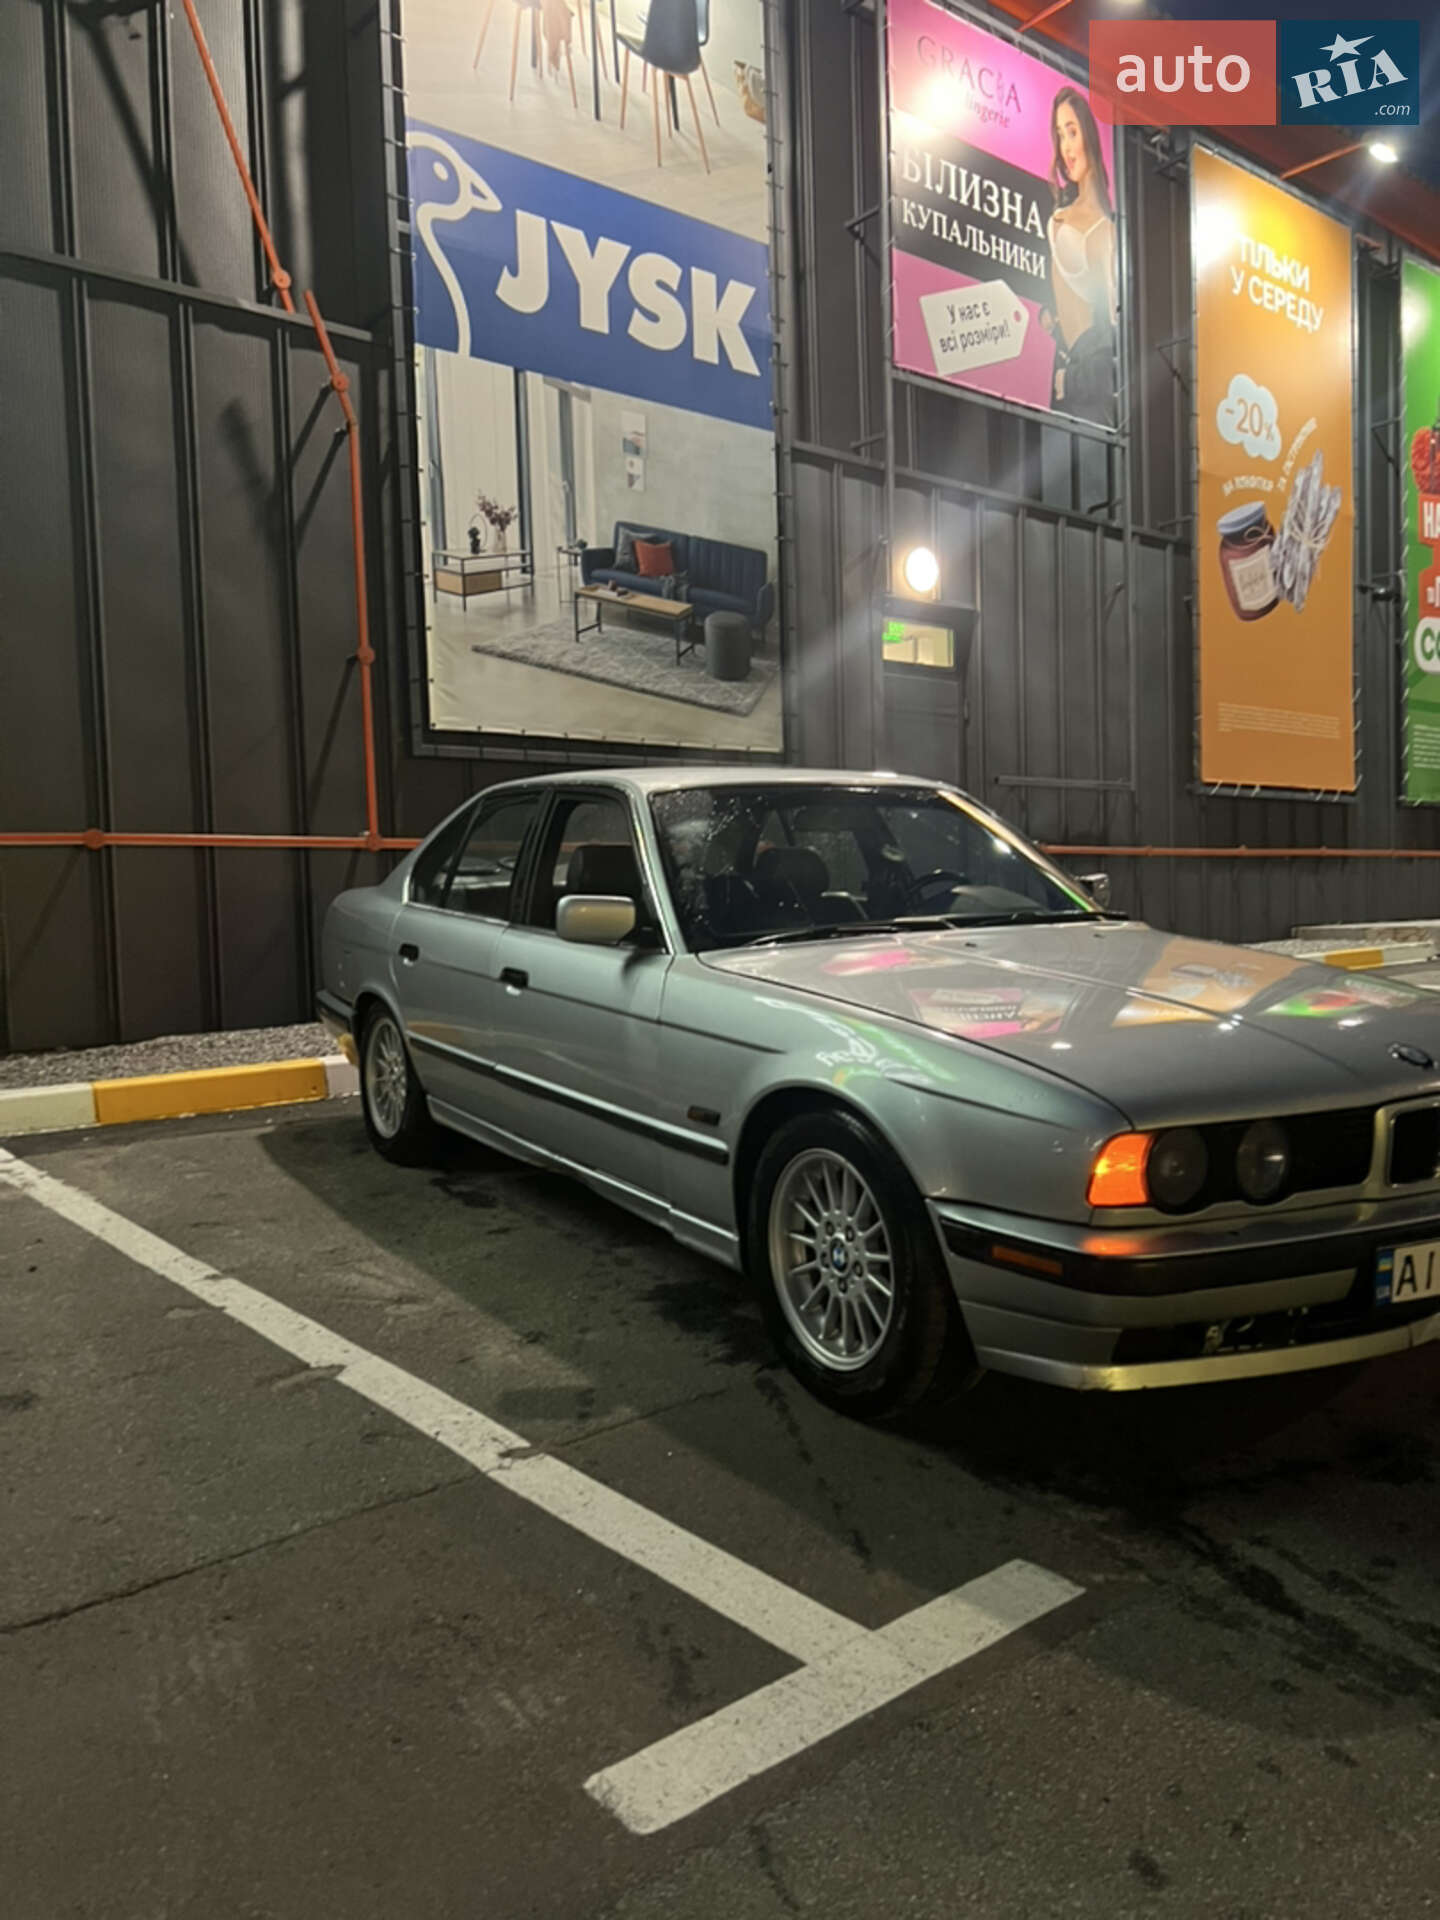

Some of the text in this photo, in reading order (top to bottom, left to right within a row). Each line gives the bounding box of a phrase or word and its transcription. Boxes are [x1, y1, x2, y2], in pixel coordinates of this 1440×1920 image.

[902, 150, 1047, 240] БІЛИЗНА
[902, 198, 1047, 280] КУПАЛЬНИКИ
[495, 209, 761, 377] JYSK
[947, 304, 956, 325] У
[959, 303, 981, 321] нас
[1229, 265, 1324, 334] У СЕРЕДУ
[940, 329, 959, 353] всі
